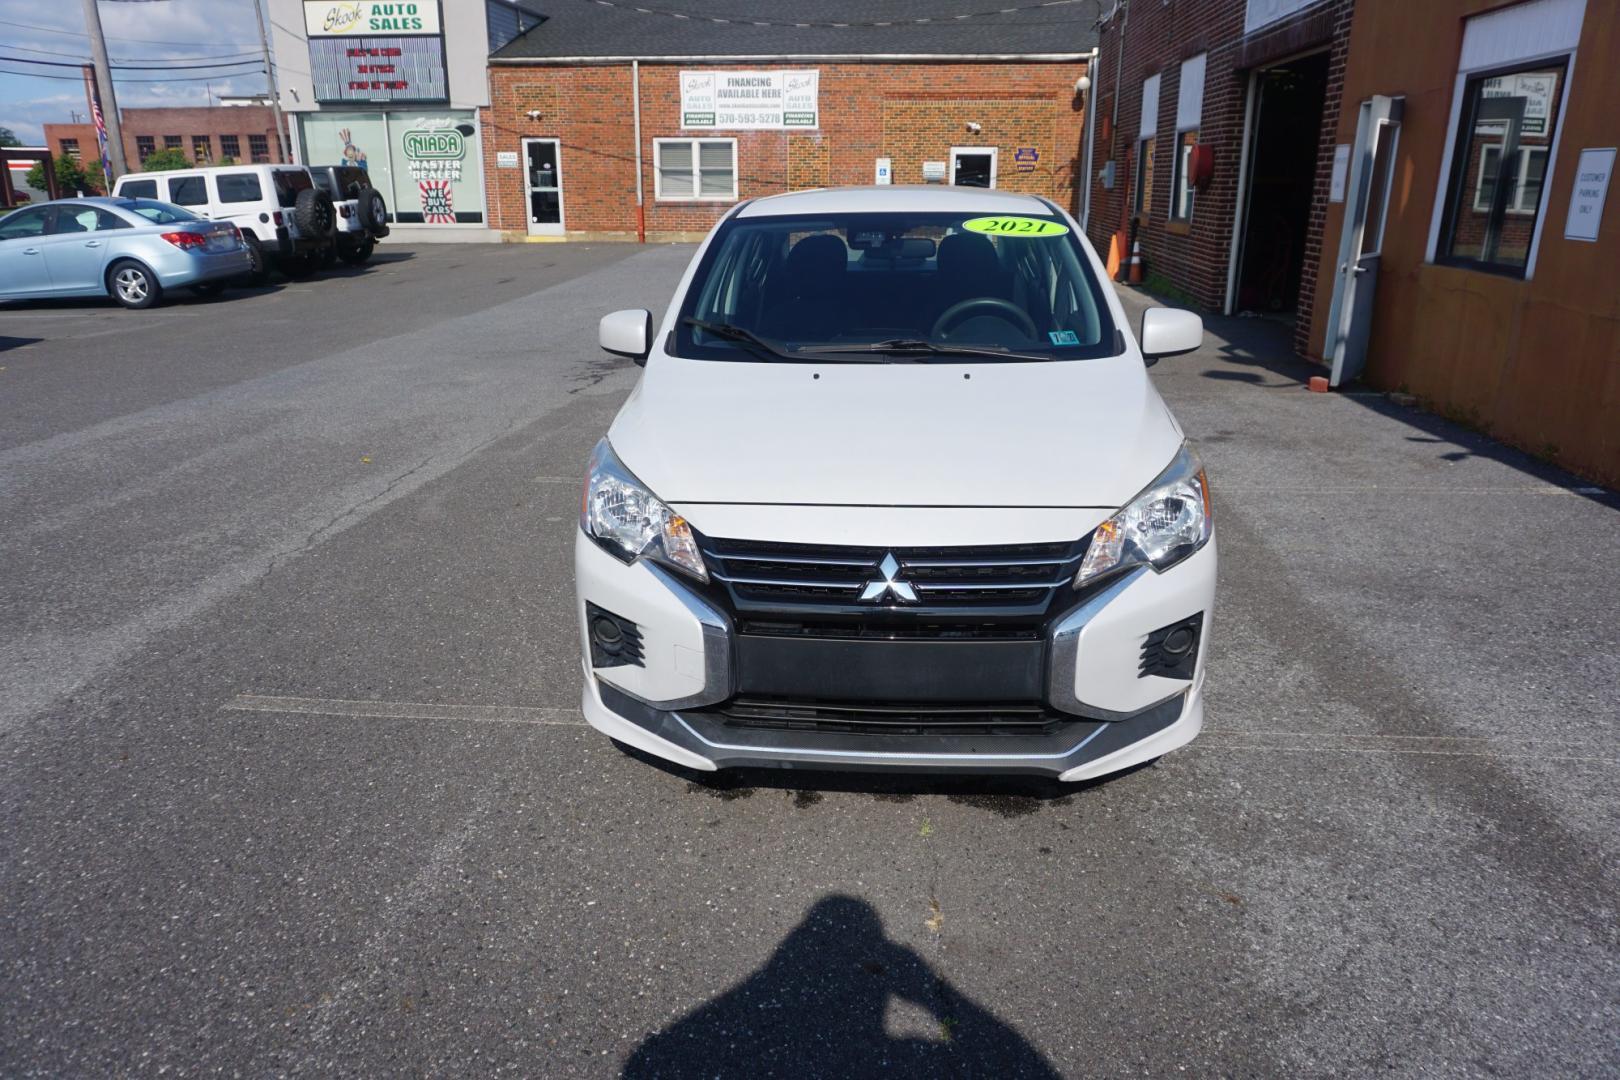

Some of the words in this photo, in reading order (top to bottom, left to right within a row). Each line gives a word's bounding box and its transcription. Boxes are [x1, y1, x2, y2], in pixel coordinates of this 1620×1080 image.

[371, 3, 417, 16] AUTO
[323, 4, 363, 31] Skook
[369, 17, 423, 30] SALES
[727, 78, 772, 87] FINANCING
[717, 89, 760, 99] AVAILABLE
[761, 89, 782, 99] HERE
[719, 113, 780, 124] 570-593-5278
[408, 135, 458, 153] NIADA
[410, 160, 461, 170] MASTER
[412, 170, 460, 179] DEALER
[428, 188, 444, 197] WE
[427, 197, 446, 206] BUY
[424, 206, 450, 214] CARS
[984, 220, 1047, 233] 2021
